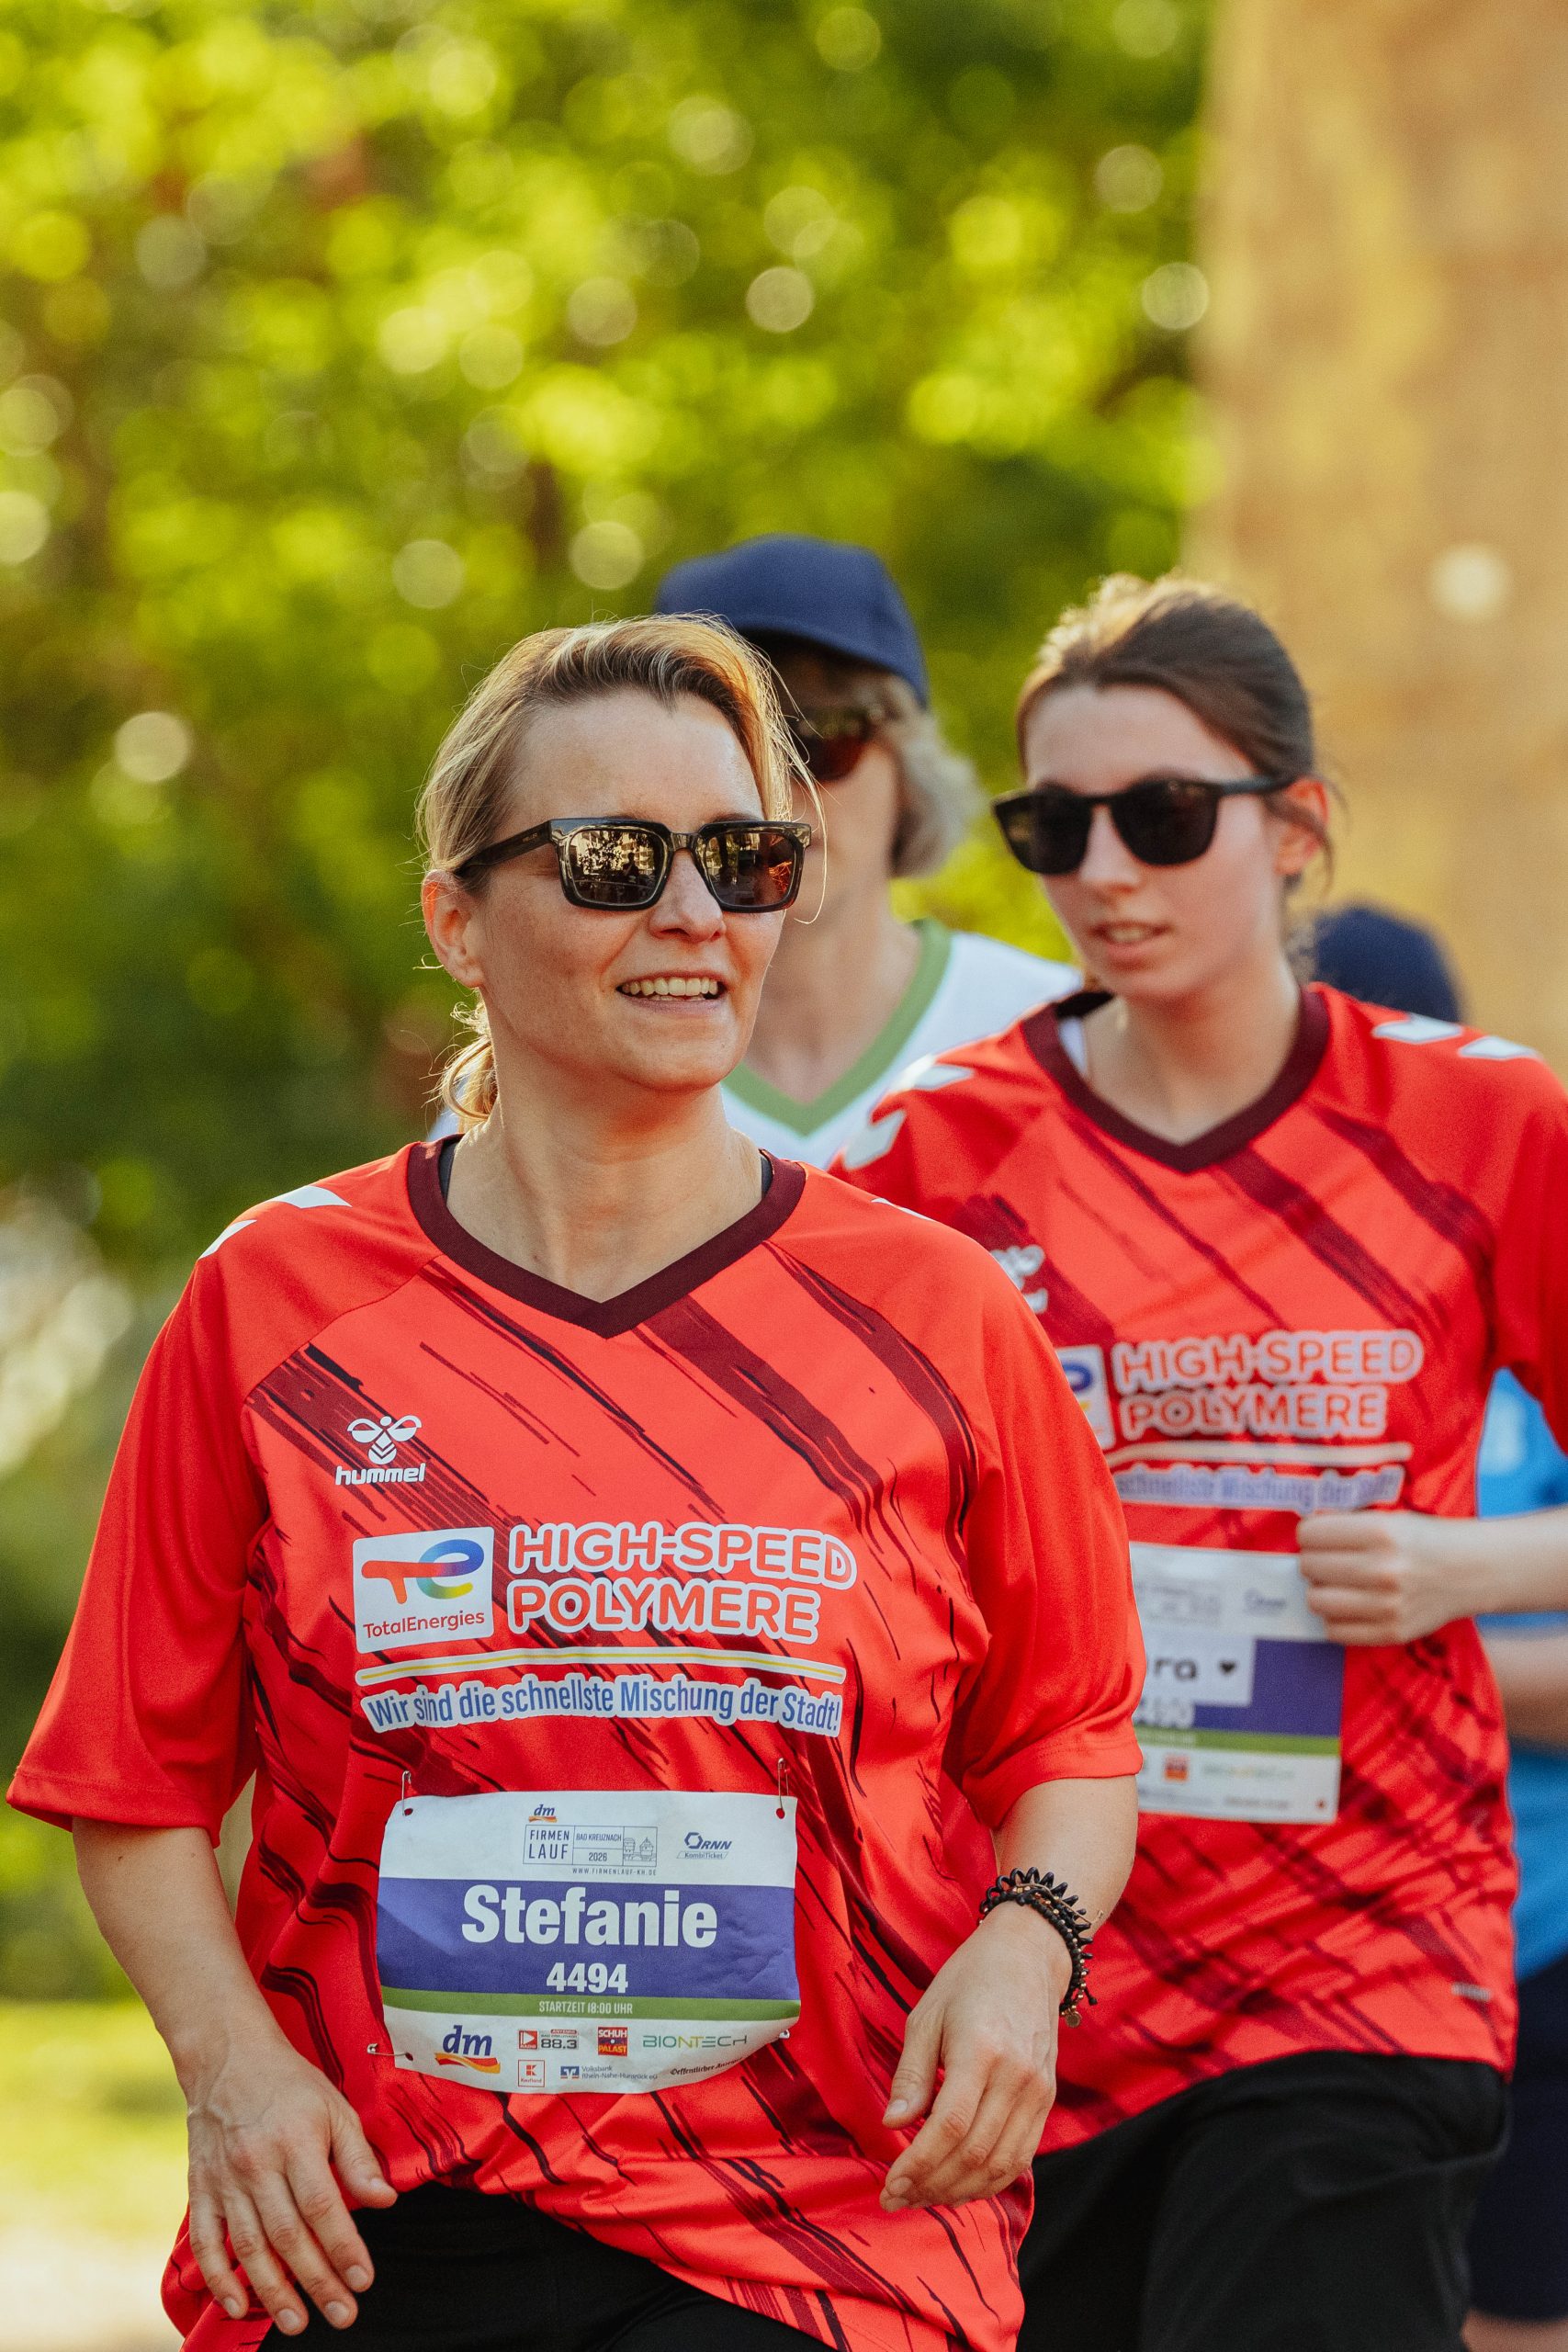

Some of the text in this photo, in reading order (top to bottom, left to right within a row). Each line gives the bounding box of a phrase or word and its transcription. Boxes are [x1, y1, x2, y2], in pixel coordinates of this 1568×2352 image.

[1124, 1390, 1382, 1432] POLYMERE
[335, 1463, 426, 1486] hummel
[513, 1524, 854, 1585] HIGH-SPEED
[511, 1580, 816, 1639] POLYMERE
[363, 1610, 485, 1638] TotalEnergies
[367, 1679, 840, 1732] Wir sind die schnellste Mischung der Stadt!
[534, 1804, 555, 1816] dm
[530, 1830, 570, 1841] FIRMEN
[576, 1833, 622, 1842] BAD KREUZNACH
[528, 1843, 569, 1860] LAUF
[461, 1884, 717, 1948] Stefanie
[546, 1962, 629, 1994] 4494
[538, 2001, 633, 2015] STARTZEIT 18:00 UHR
[442, 2024, 492, 2056] dm
[540, 2038, 578, 2050] 88.3
[598, 2029, 627, 2039] SCHUH
[642, 2034, 748, 2049] BIONTECH
[598, 2044, 626, 2053] PALAST
